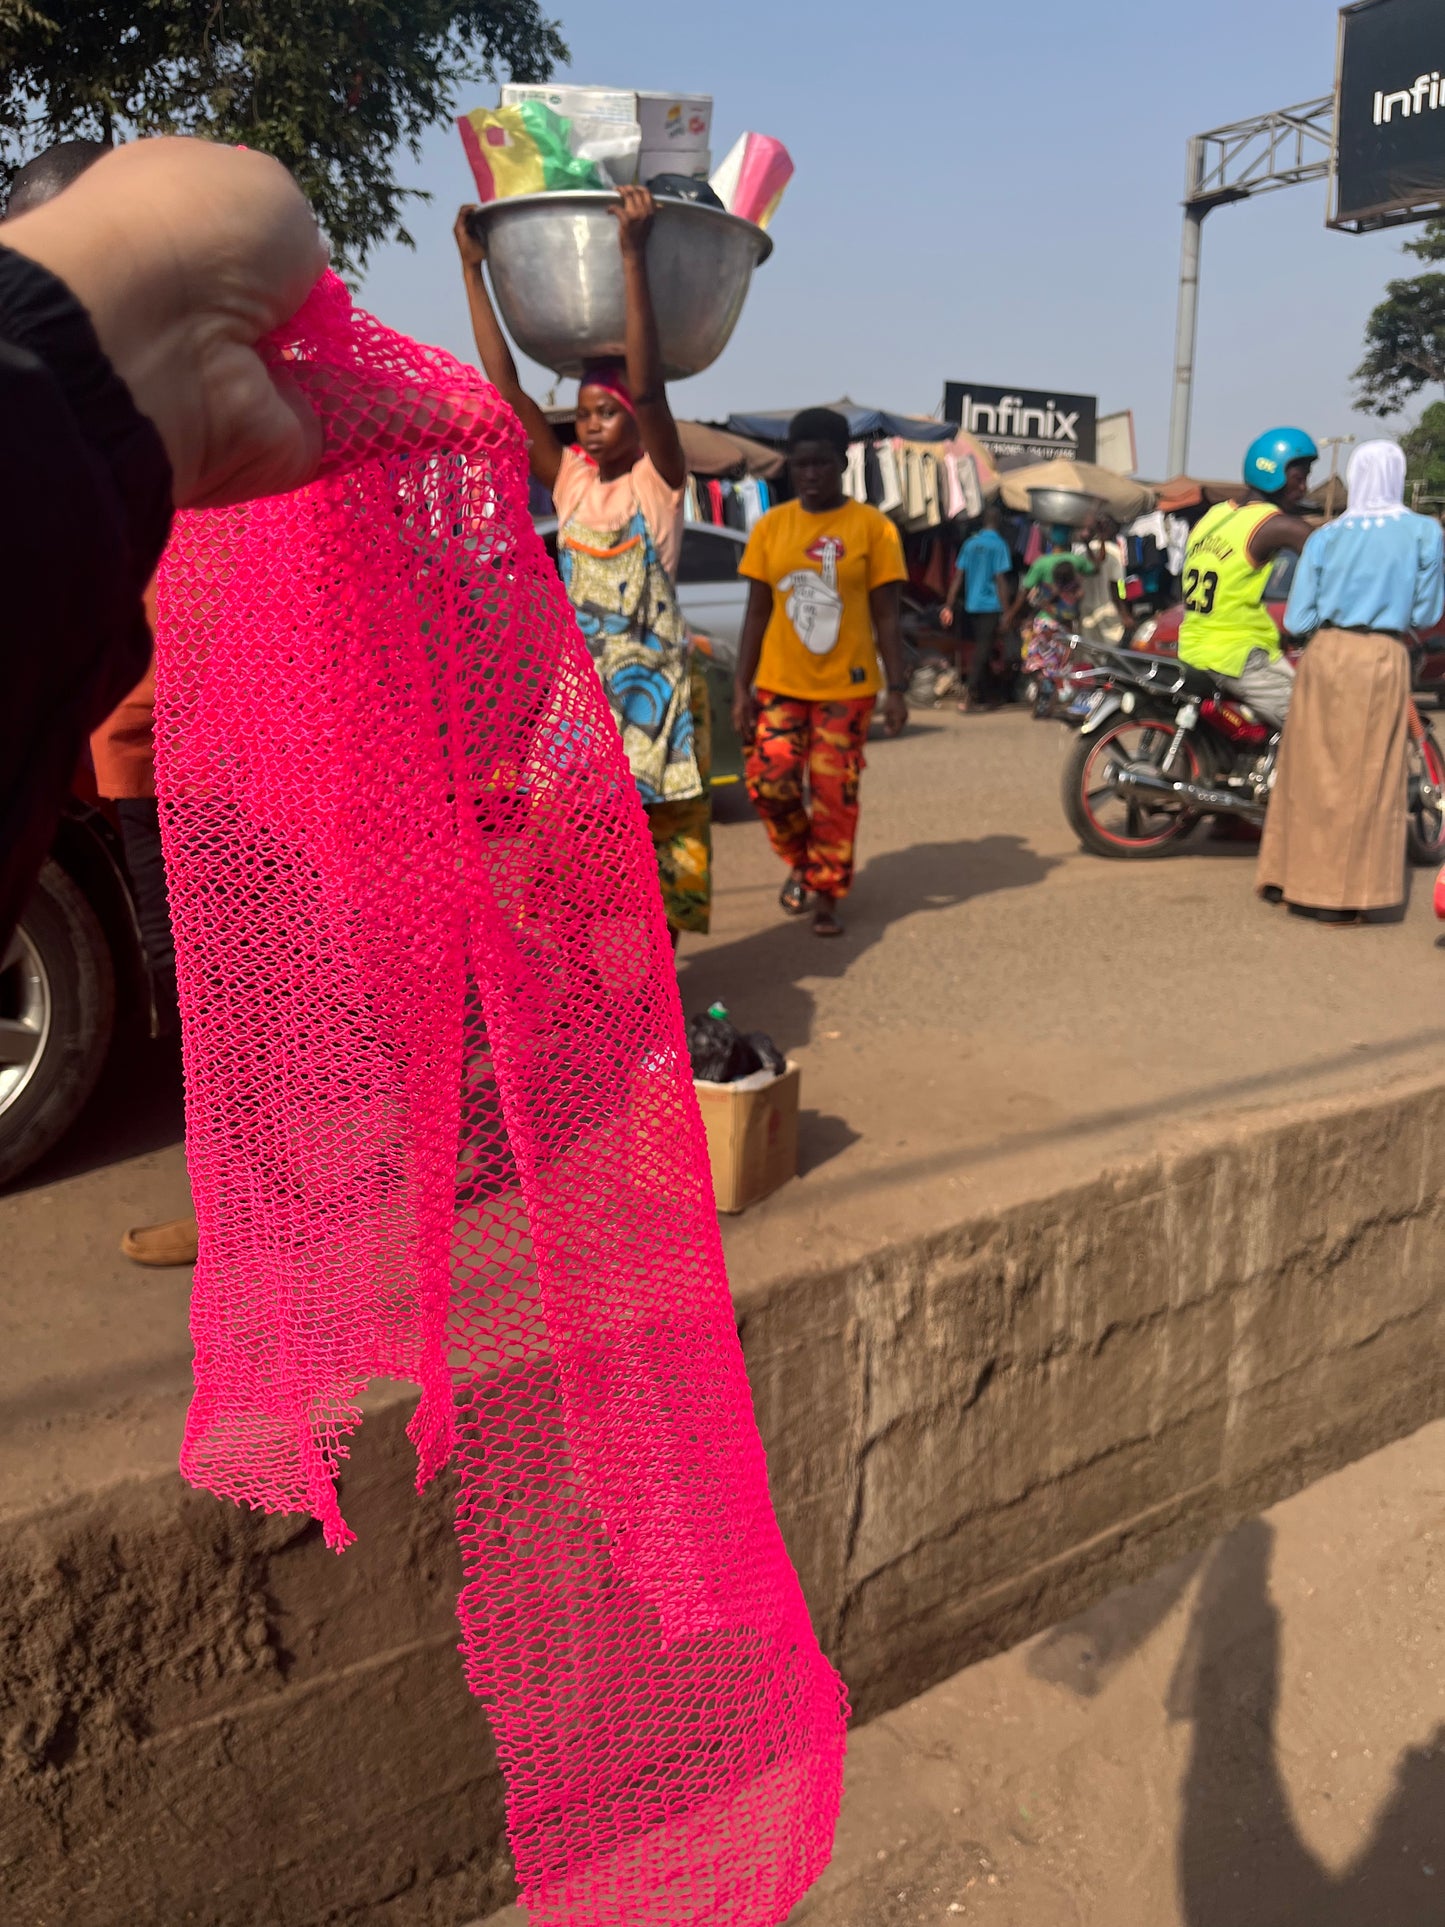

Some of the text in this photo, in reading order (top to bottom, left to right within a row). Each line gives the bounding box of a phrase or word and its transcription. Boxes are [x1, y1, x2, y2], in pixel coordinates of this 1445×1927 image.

[1373, 71, 1445, 125] Infi
[962, 394, 1079, 440] Infinix
[1184, 568, 1218, 614] 23
